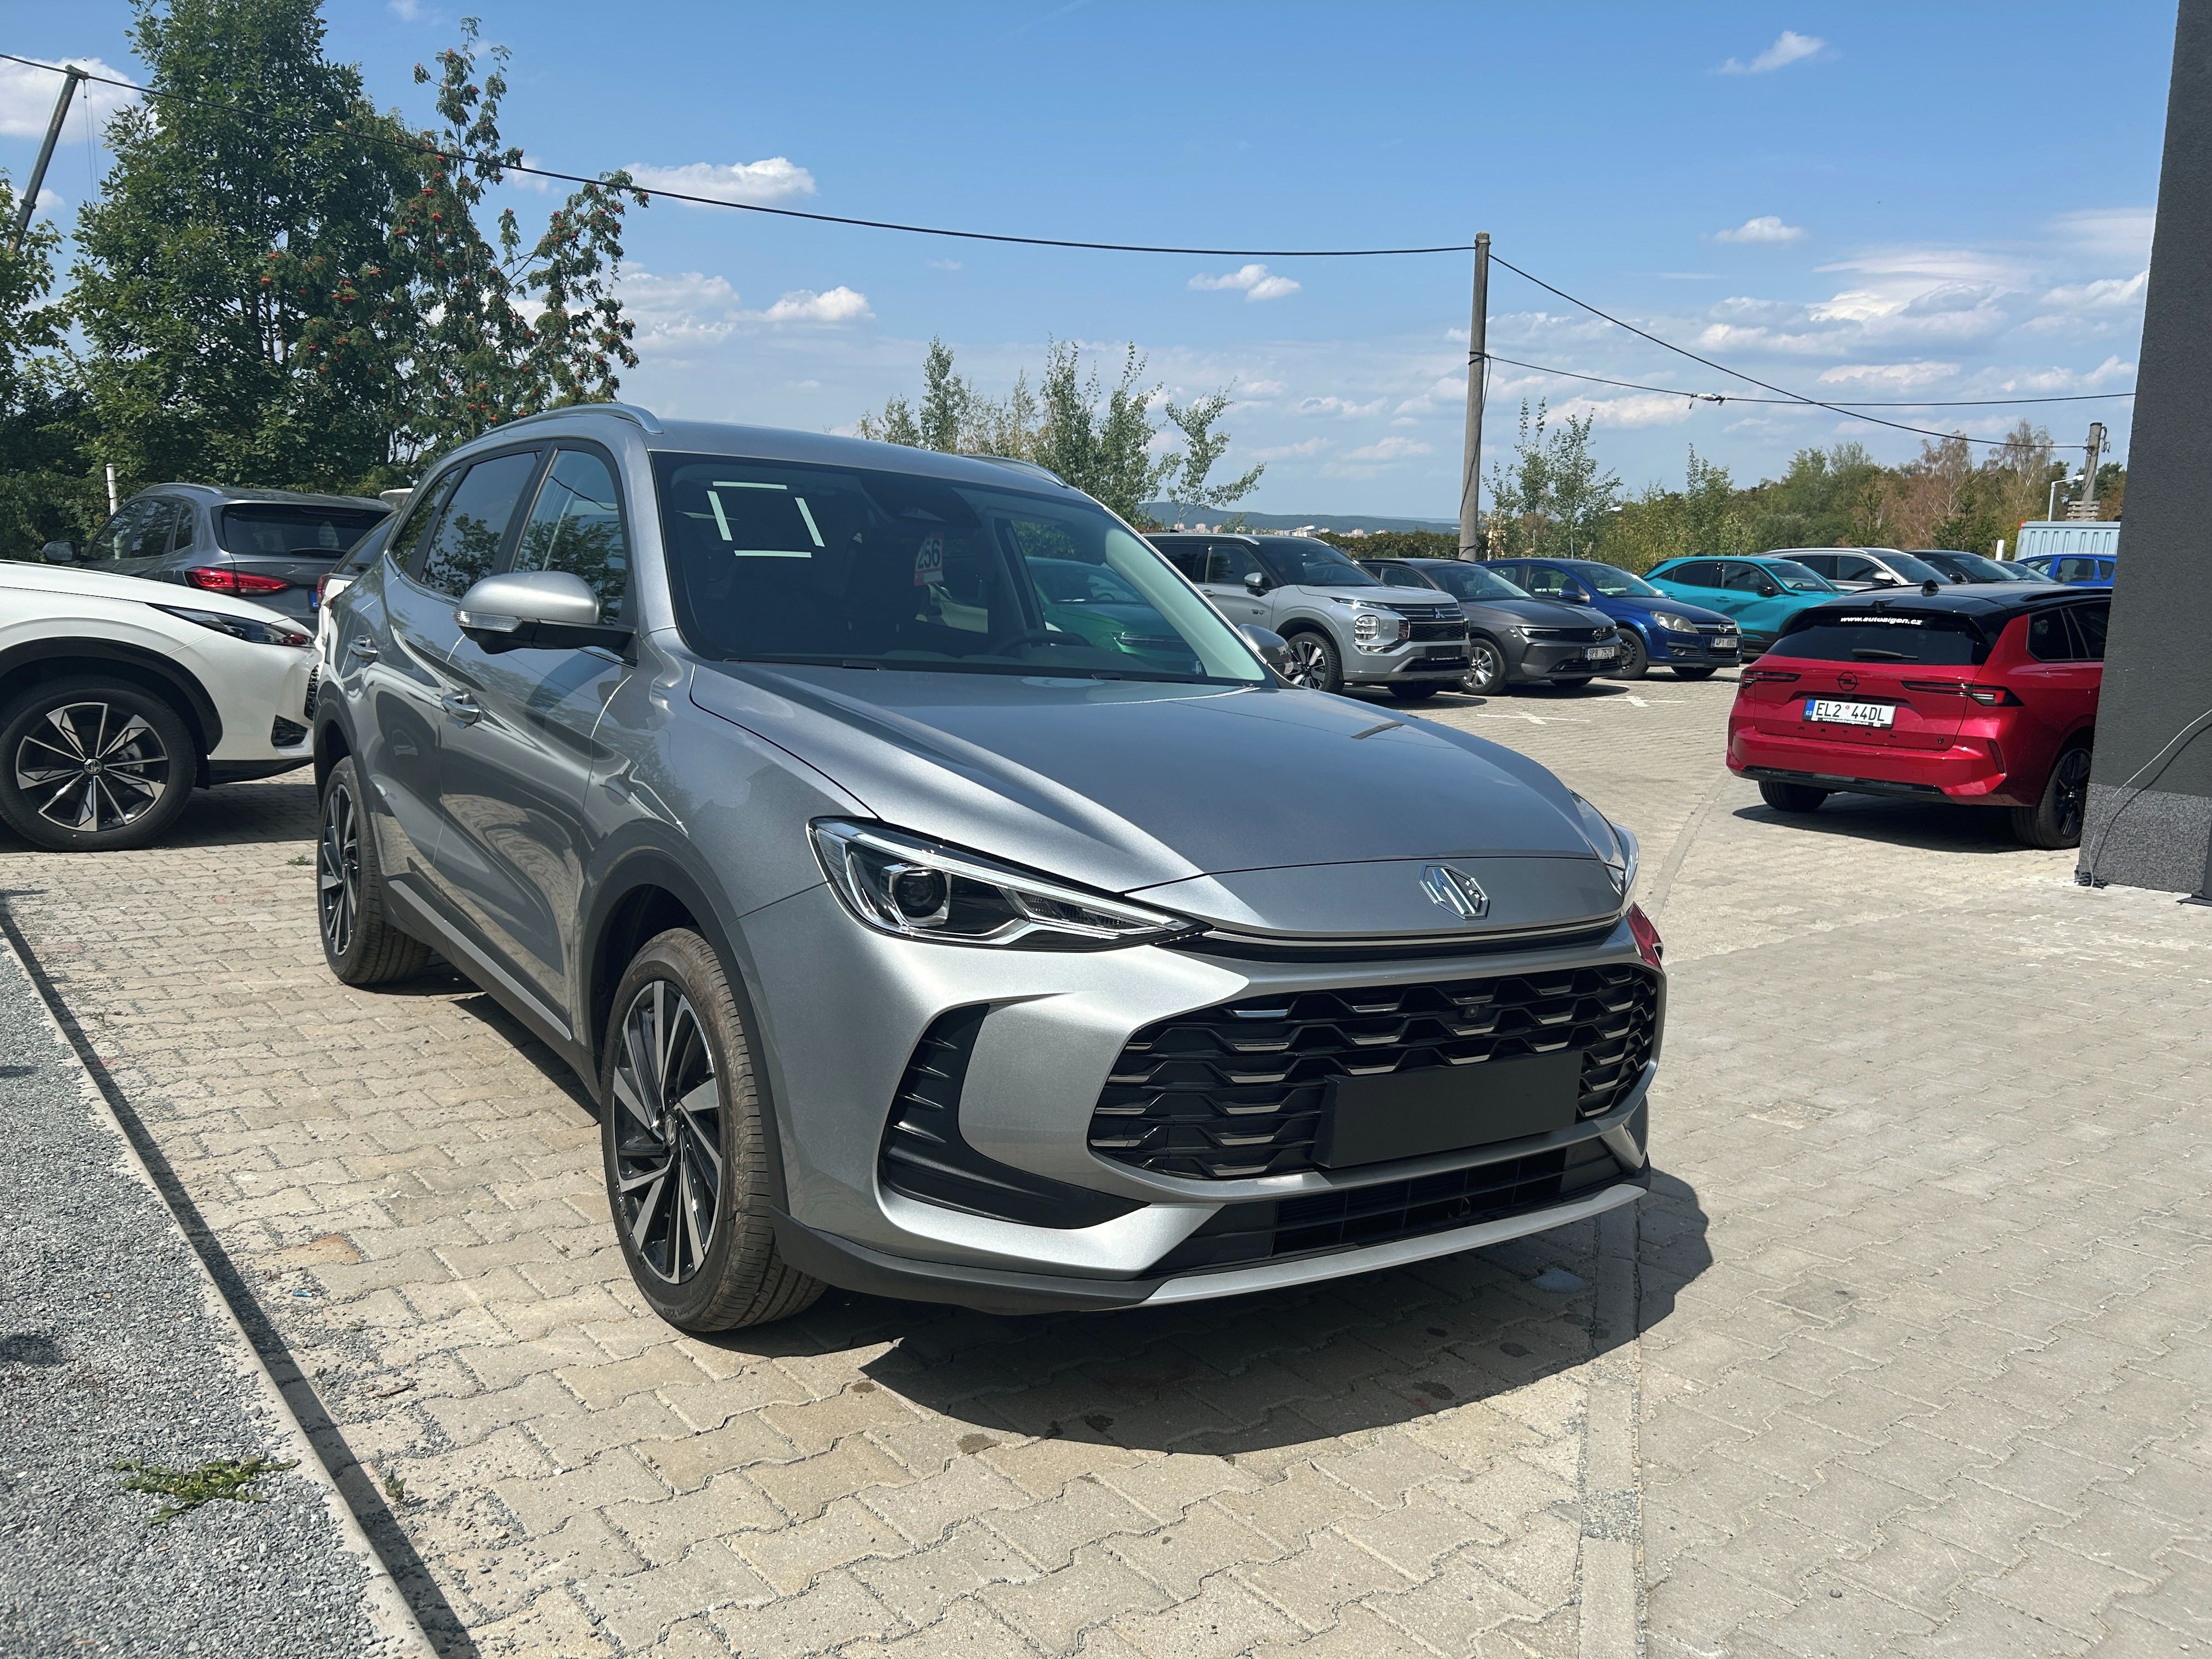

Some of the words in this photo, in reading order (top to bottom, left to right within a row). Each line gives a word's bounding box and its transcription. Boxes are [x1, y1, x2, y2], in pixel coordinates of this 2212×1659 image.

[917, 539, 941, 569] 256
[1816, 702, 1842, 718] EL2
[1851, 706, 1884, 721] 44DL
